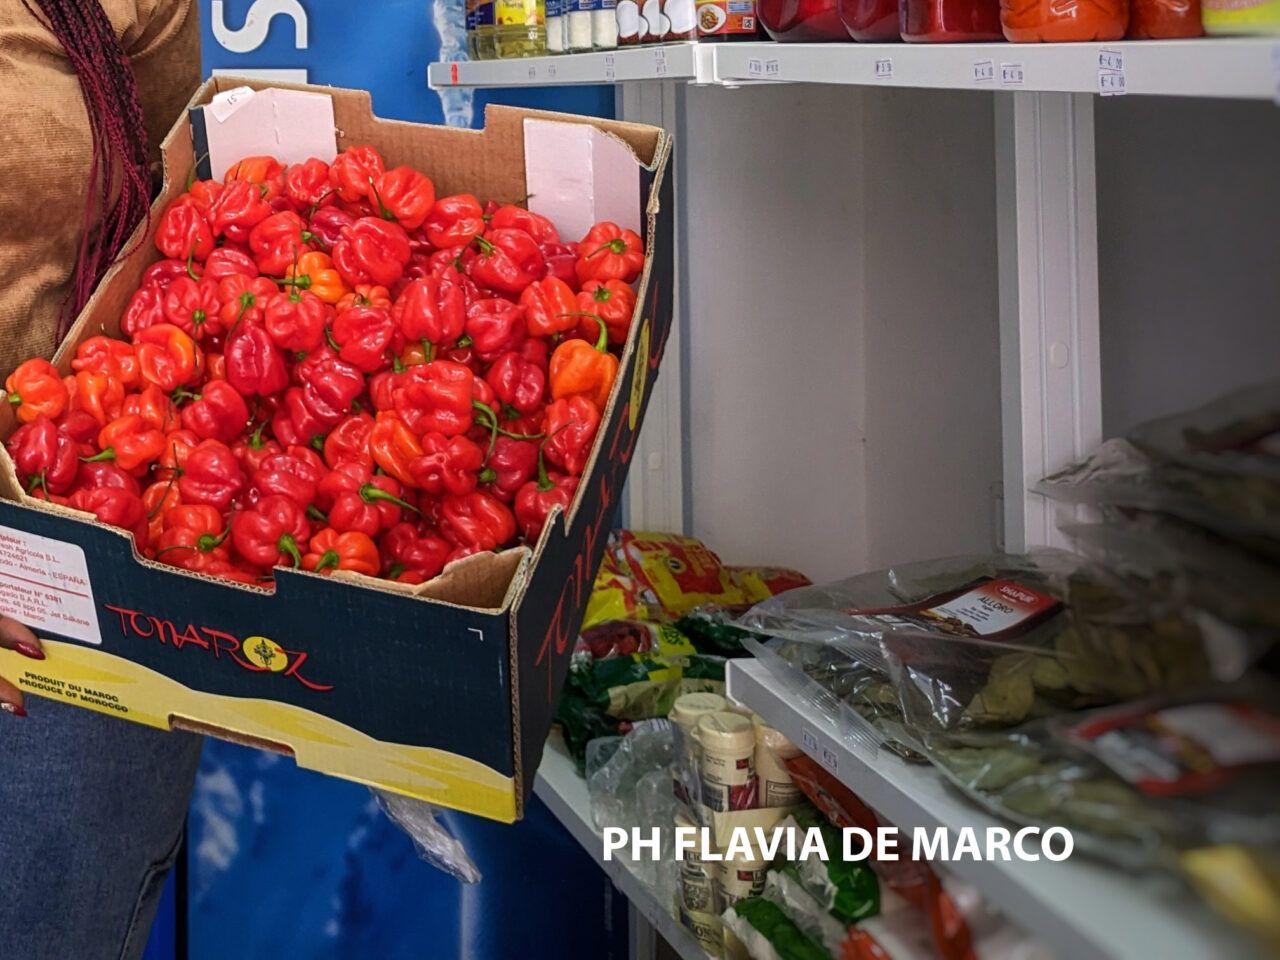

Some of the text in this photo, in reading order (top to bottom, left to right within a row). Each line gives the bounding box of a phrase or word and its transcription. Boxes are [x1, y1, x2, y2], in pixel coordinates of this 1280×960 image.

[52, 570, 86, 587] ESPAÑA
[18, 677, 128, 713] PRODUCE OF MOROCCO
[24, 671, 119, 702] PRODUIT DU MAROC
